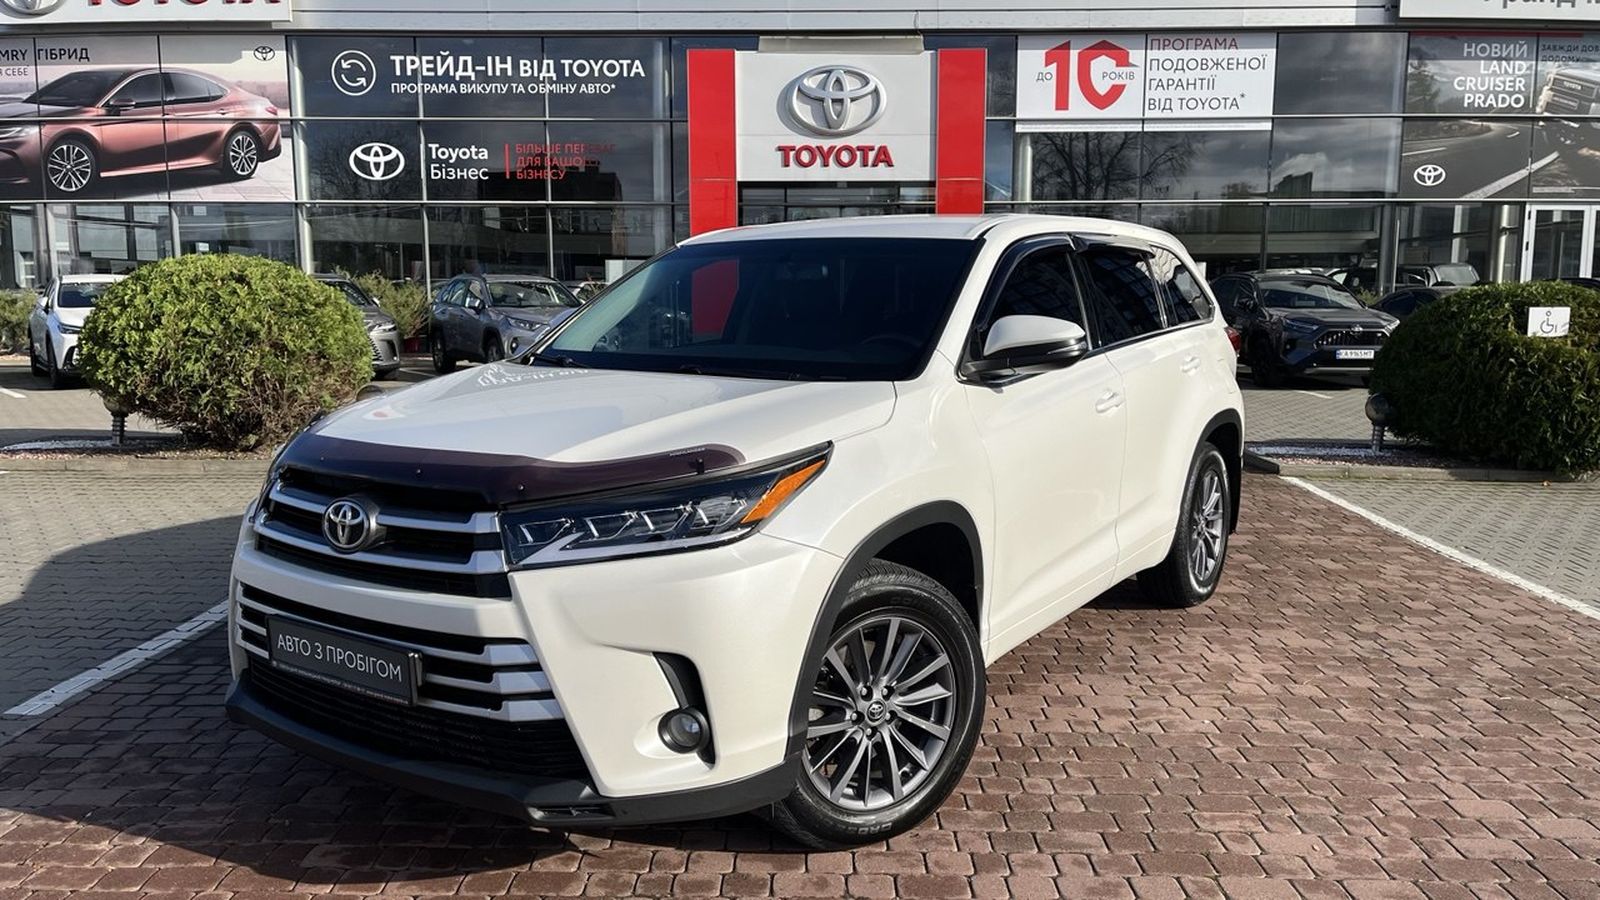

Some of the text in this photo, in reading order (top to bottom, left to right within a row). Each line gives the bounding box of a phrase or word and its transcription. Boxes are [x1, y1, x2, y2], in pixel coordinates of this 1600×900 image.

[1150, 38, 1239, 51] ПРОГРАМА
[1463, 41, 1528, 58] НОВИЙ
[37, 47, 90, 62] ГІБРИД
[389, 51, 645, 80] ТРЕЙД-ІН ВІД TOYOTA
[1149, 54, 1268, 72] ПОДОВЖЕНОЇ
[1479, 60, 1527, 75] LAND
[1036, 71, 1053, 82] ДО
[1101, 71, 1135, 81] РОКІВ
[1149, 75, 1216, 91] ГАРАНТІЇ
[1453, 77, 1526, 91] CRUISER
[391, 83, 457, 94] ПРОГРАМА
[460, 83, 508, 94] ВИКУПУ
[511, 83, 525, 94] ТА
[527, 83, 577, 94] ОБМІНУ
[1148, 97, 1174, 114] ВІД
[1463, 94, 1525, 108] PRADO
[428, 143, 489, 161] Toyota
[776, 145, 895, 168] TOYOTA
[516, 156, 541, 168] ДЛЯ
[430, 164, 489, 181] Бізнес
[516, 169, 566, 180] БІЗНЕСУ
[277, 633, 311, 656] АВТО
[314, 642, 323, 660] З
[326, 645, 402, 683] ПРОБІГОМ
